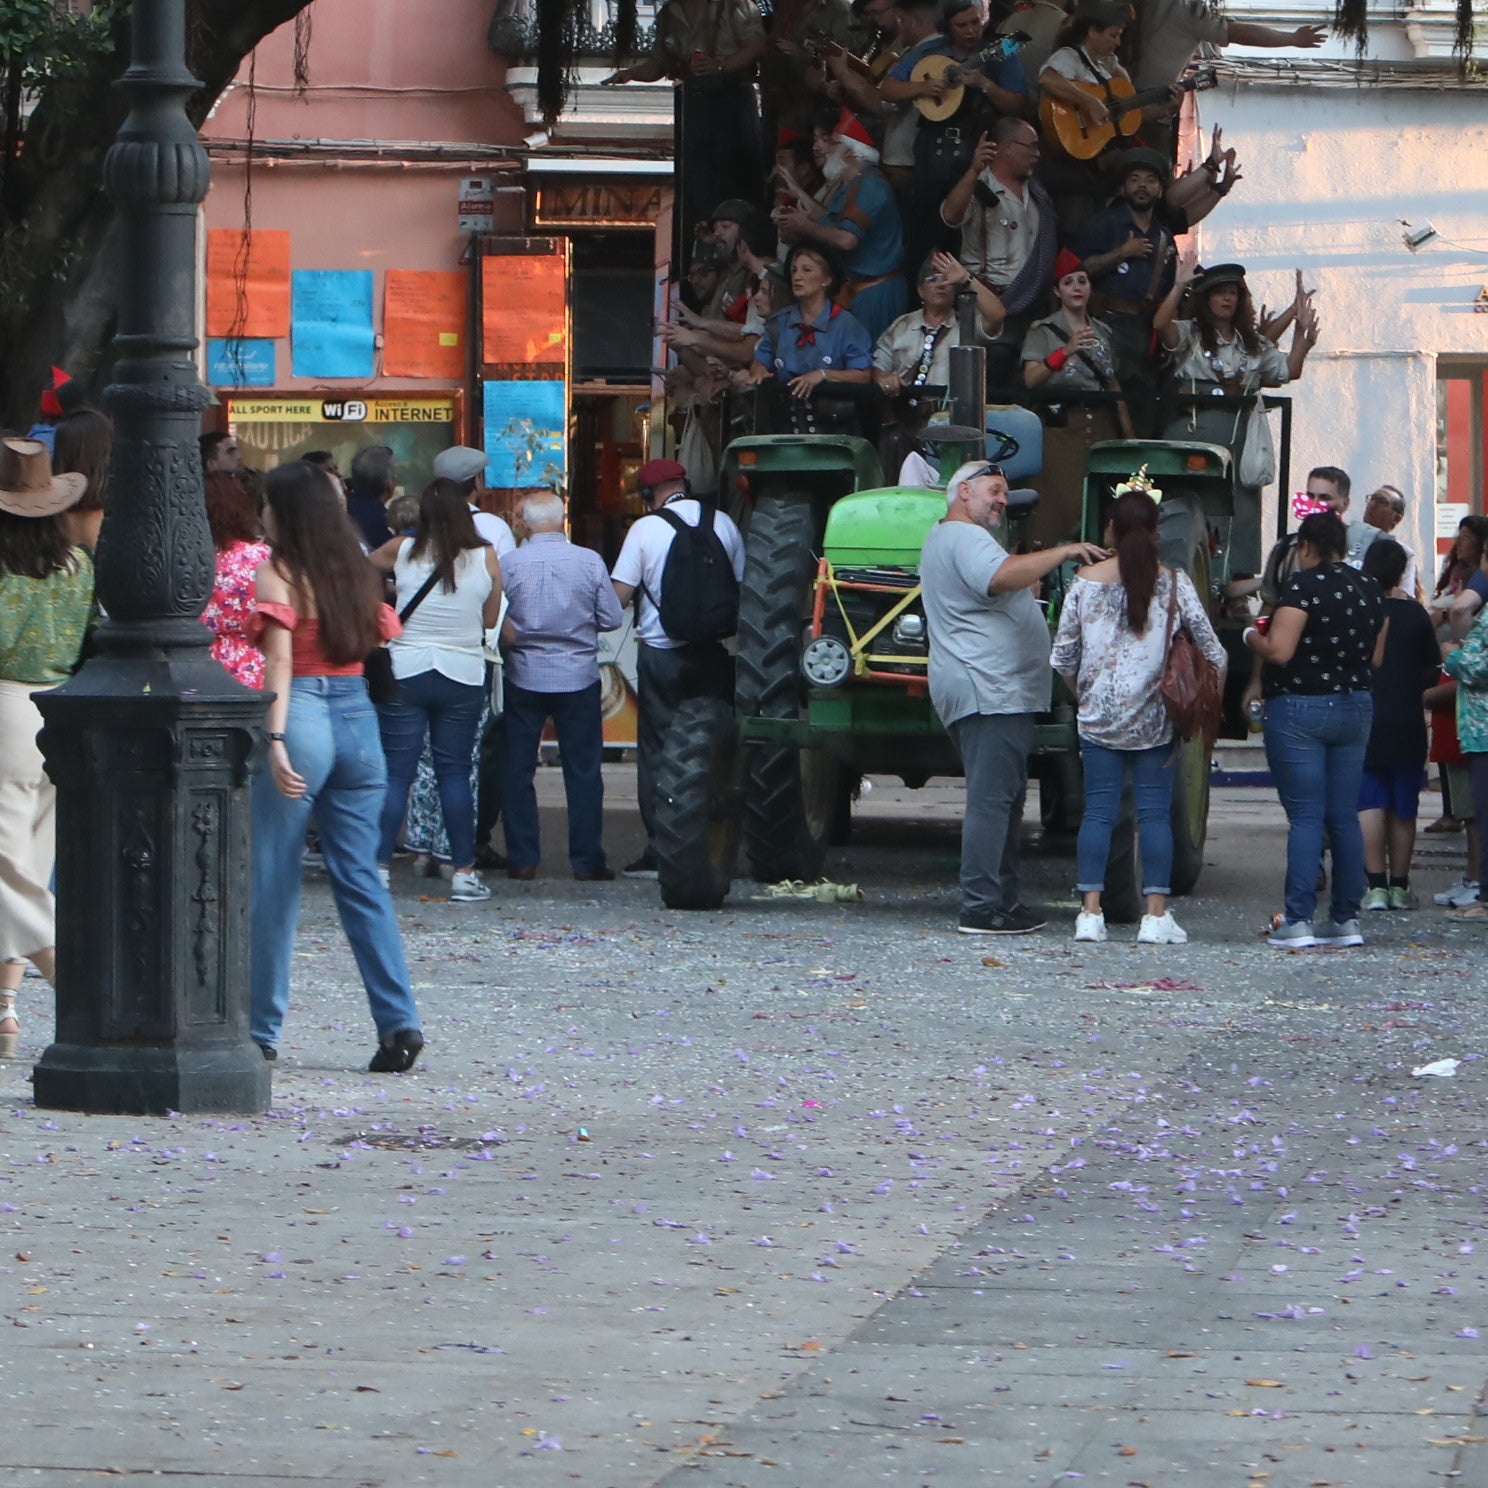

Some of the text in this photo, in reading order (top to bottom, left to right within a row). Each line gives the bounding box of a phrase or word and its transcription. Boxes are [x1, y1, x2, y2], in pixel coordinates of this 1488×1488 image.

[230, 405, 312, 414] ALL SPORT HERE
[374, 408, 454, 421] INTERNET
